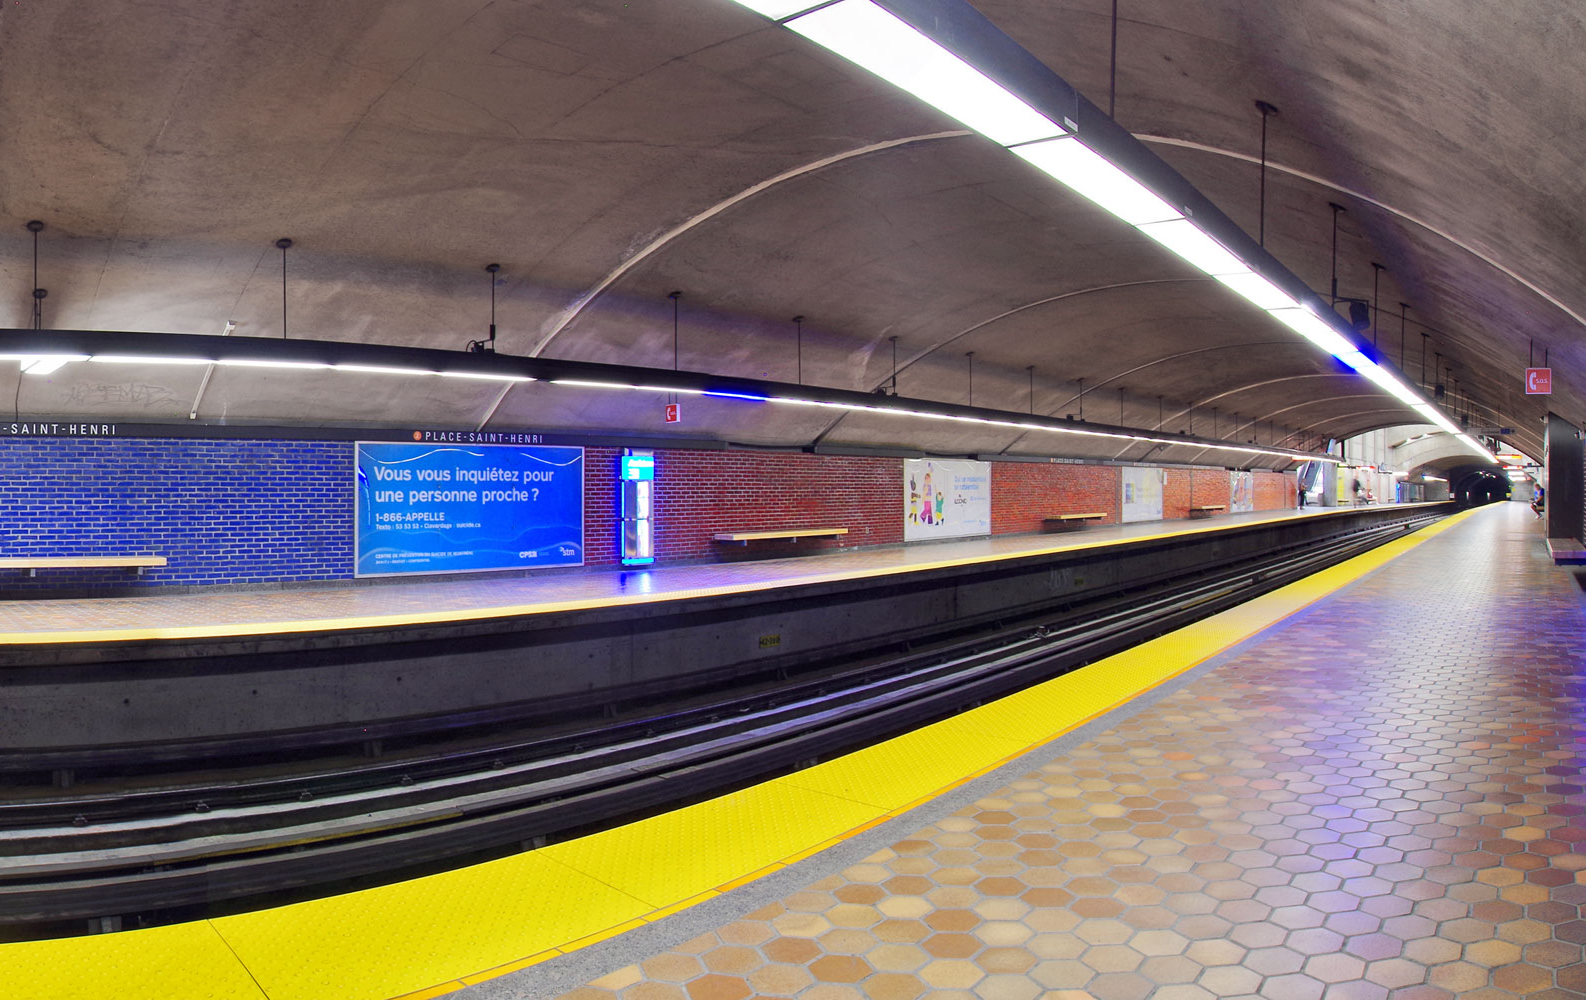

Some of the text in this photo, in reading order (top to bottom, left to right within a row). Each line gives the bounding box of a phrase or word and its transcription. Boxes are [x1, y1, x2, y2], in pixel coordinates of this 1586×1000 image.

[425, 431, 543, 443] PLACE-SAINT-HENRI
[374, 466, 554, 484] Vous vous inquiétez pour
[375, 491, 403, 502] une
[409, 490, 478, 505] personne
[482, 487, 528, 504] proche
[375, 512, 445, 522] 1-866-APPELLE
